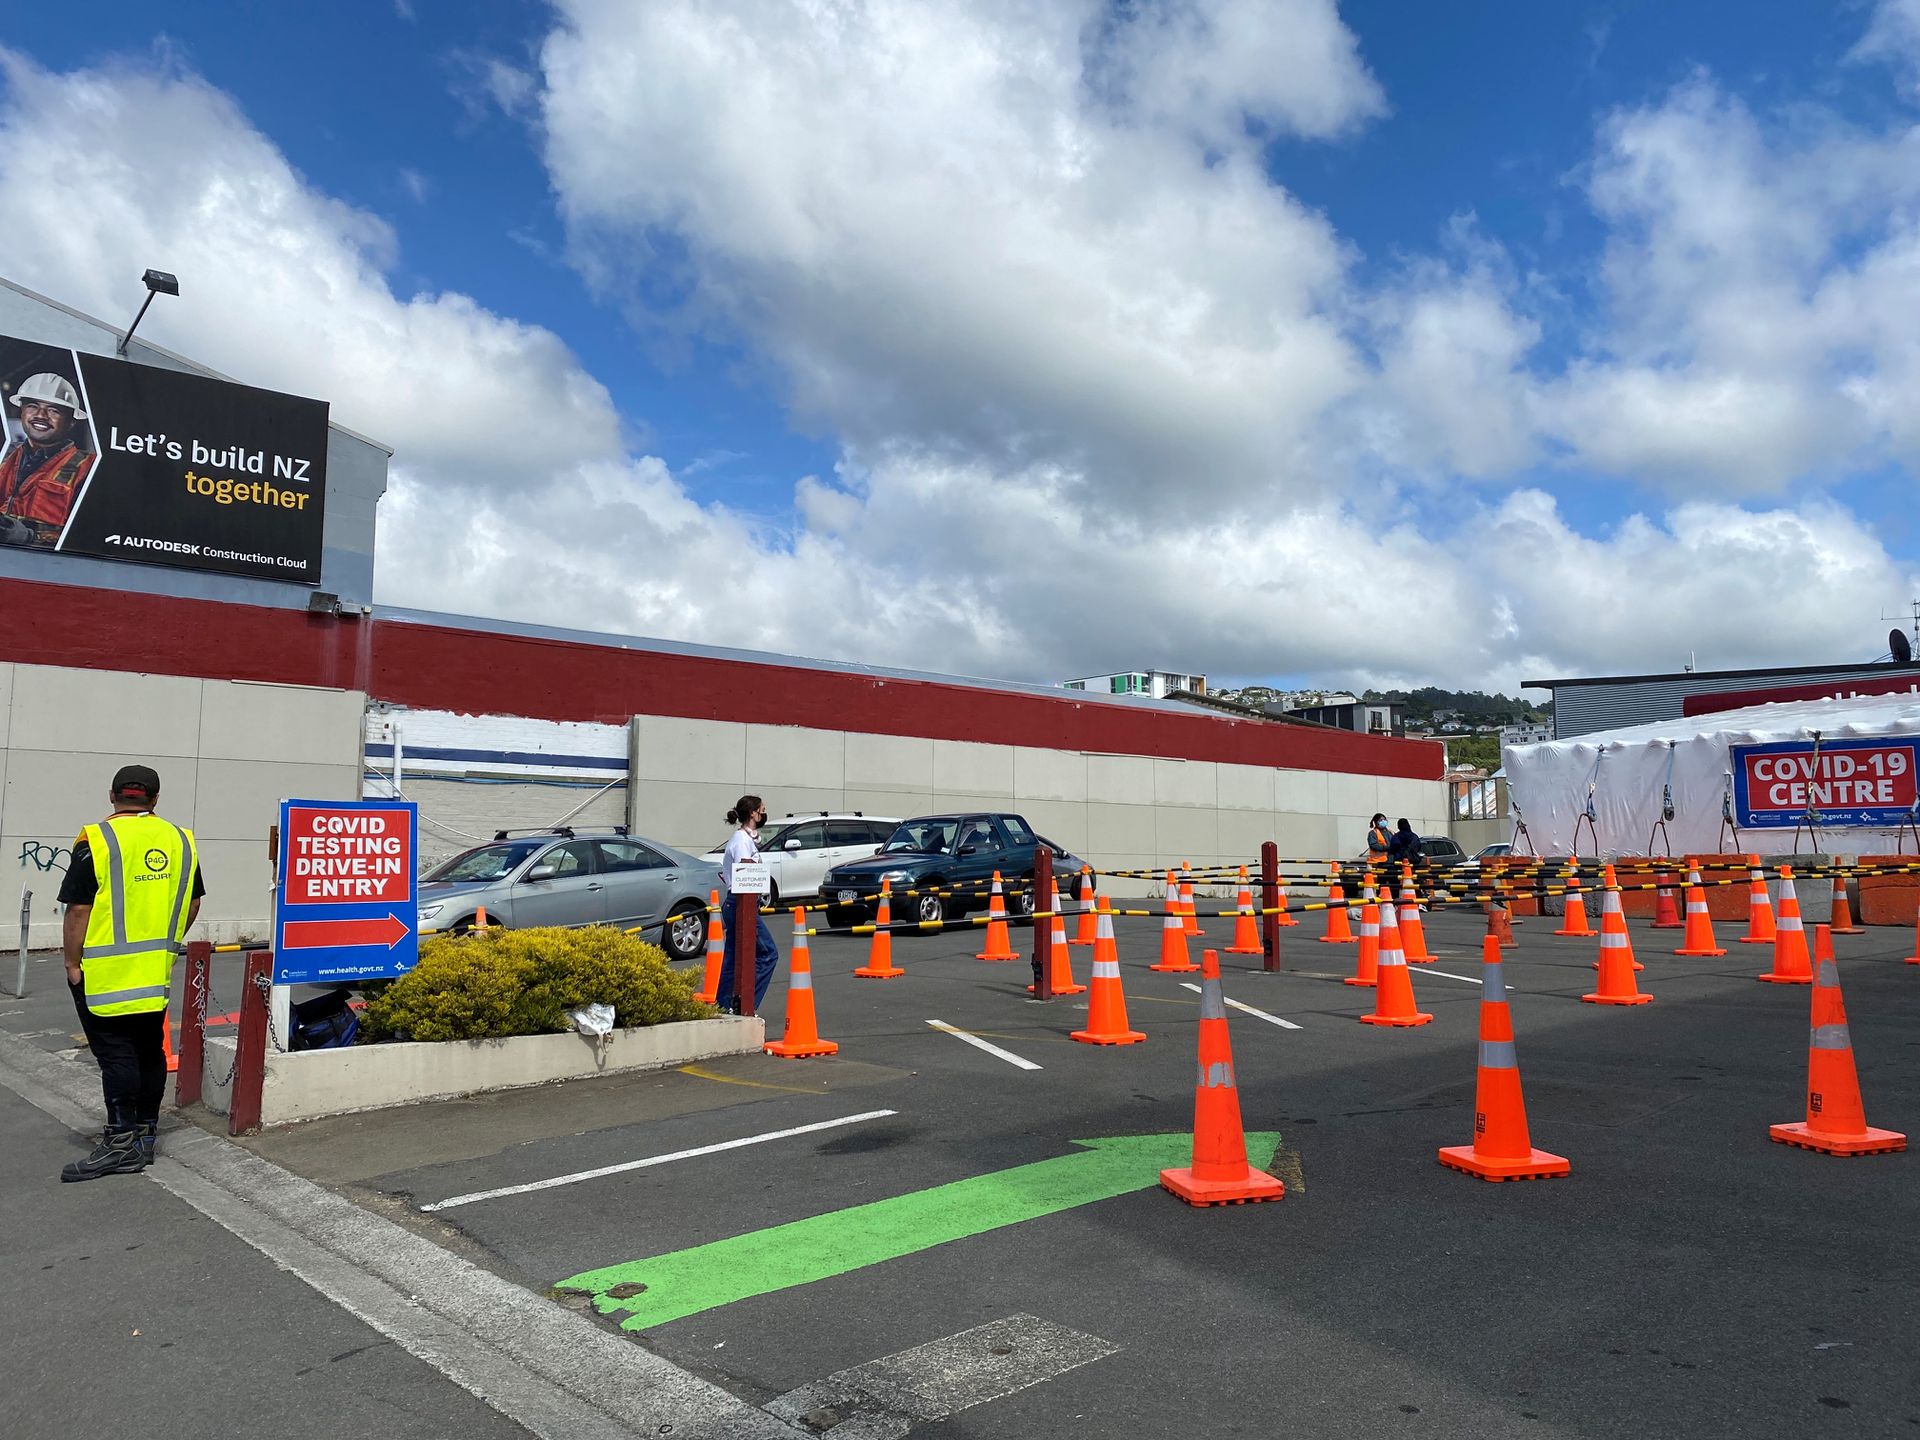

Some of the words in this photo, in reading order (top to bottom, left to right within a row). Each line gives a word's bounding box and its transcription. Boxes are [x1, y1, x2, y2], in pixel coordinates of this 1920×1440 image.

[110, 426, 183, 460] Let’s
[191, 439, 264, 474] build
[273, 455, 311, 482] NZ
[184, 471, 310, 510] together
[123, 536, 200, 555] AUTODESK
[203, 546, 274, 565] Construction
[276, 556, 307, 569] Cloud
[1754, 752, 1907, 781] COVID-19
[1769, 779, 1894, 805] CENTRE
[312, 816, 386, 834] COVID
[297, 837, 401, 855] TESTING
[148, 856, 165, 864] P4G
[295, 858, 401, 876] DRIVE-IN
[307, 878, 388, 897] ENTRY
[318, 965, 384, 975] www.health.govt.nz
